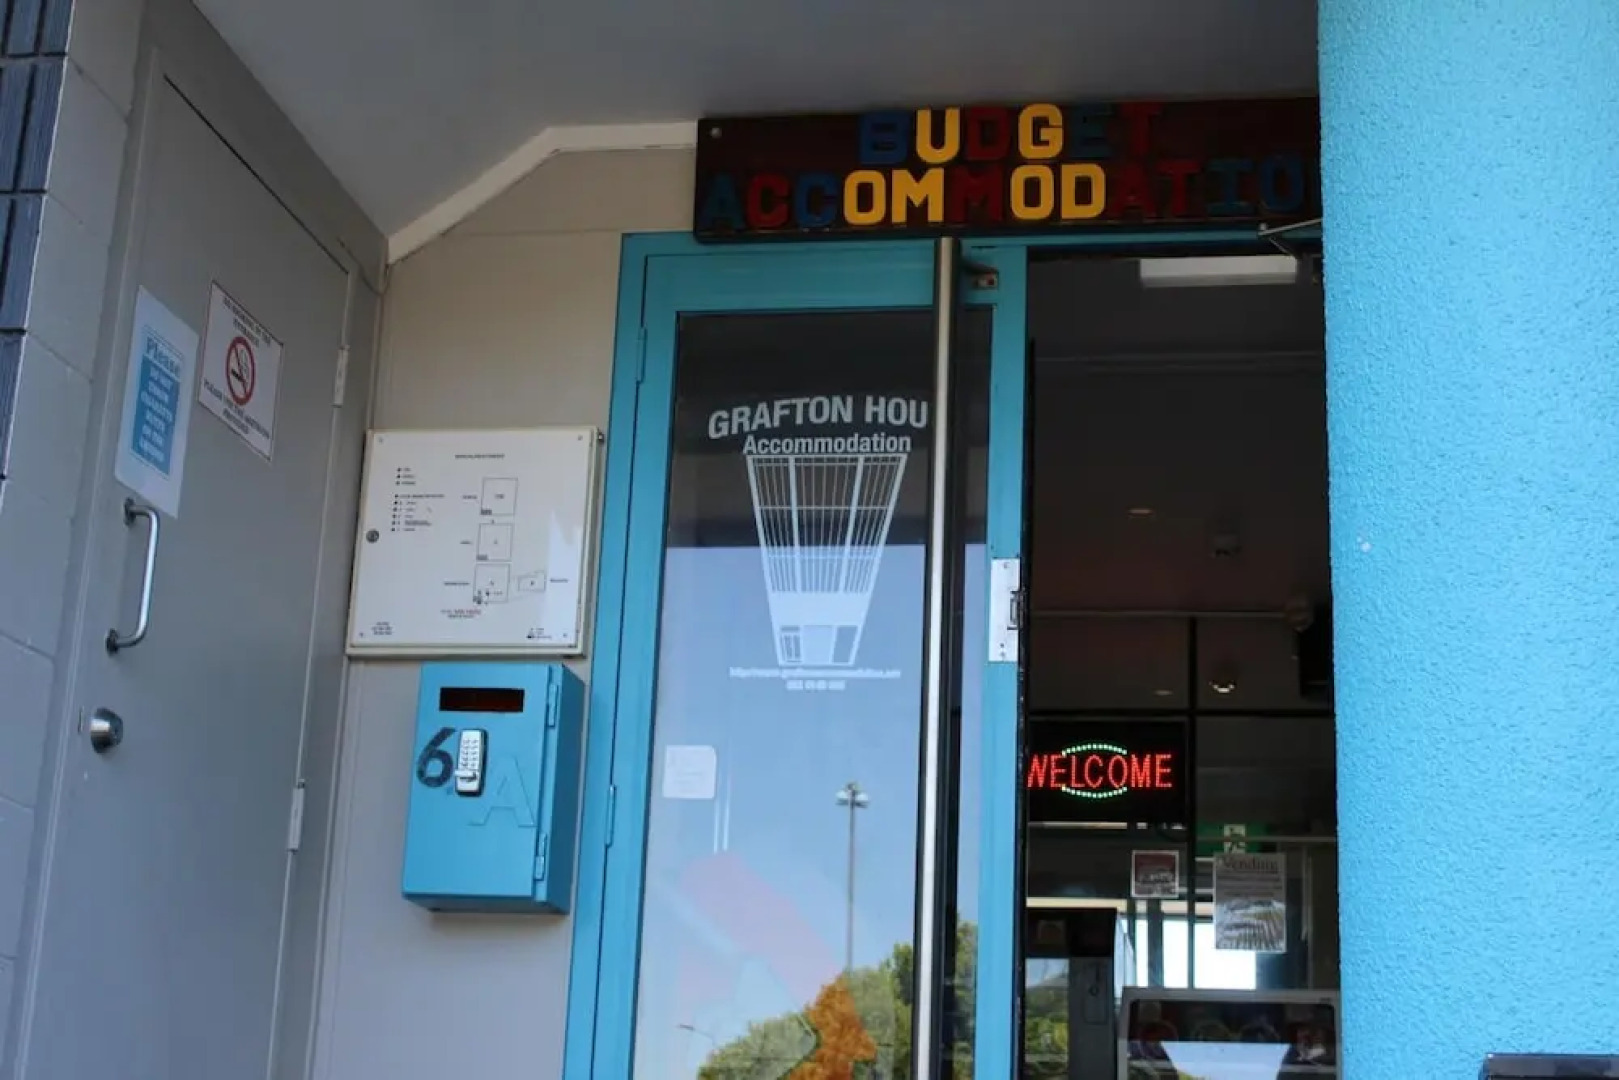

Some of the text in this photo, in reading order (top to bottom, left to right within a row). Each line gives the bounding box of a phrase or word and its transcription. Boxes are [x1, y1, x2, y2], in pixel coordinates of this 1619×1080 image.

[859, 102, 1163, 165] BUDGET
[703, 155, 1320, 230] ACCOMMODATIO
[708, 396, 853, 439] GRAFTON
[743, 432, 911, 455] Accommodation
[416, 727, 456, 788] 6
[1027, 753, 1173, 788] WELCOME
